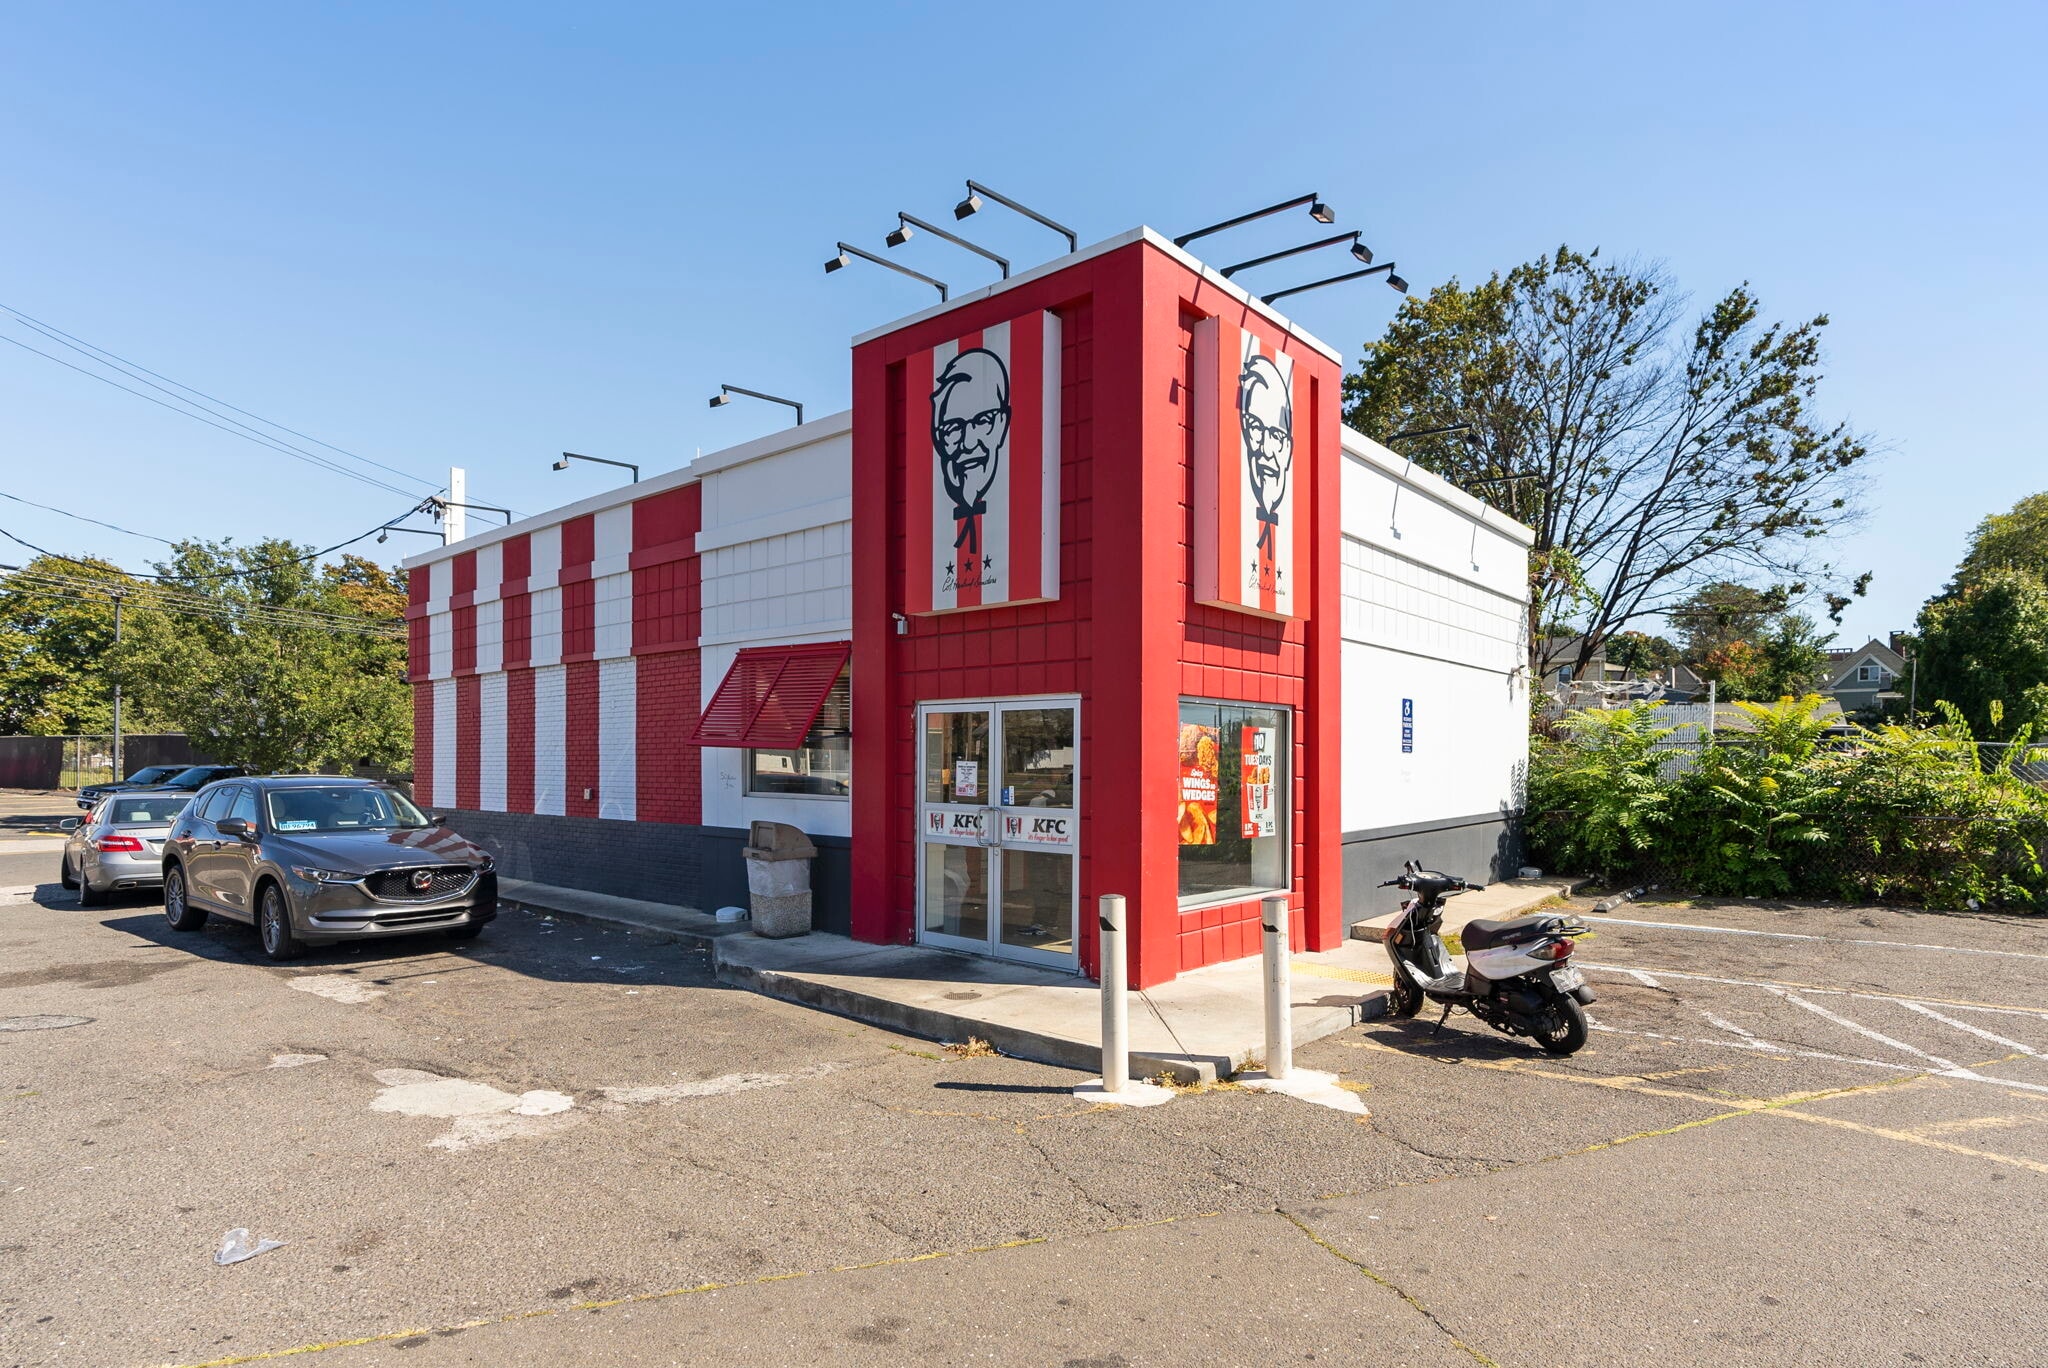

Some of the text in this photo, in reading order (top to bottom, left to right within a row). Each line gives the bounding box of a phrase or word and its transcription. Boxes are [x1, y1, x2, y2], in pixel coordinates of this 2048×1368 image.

[1245, 754, 1271, 765] TUESDAYS
[1183, 777, 1210, 789] WINGS
[1182, 789, 1215, 801] WEDGES
[953, 814, 983, 828] KFC
[1032, 818, 1066, 834] KFC
